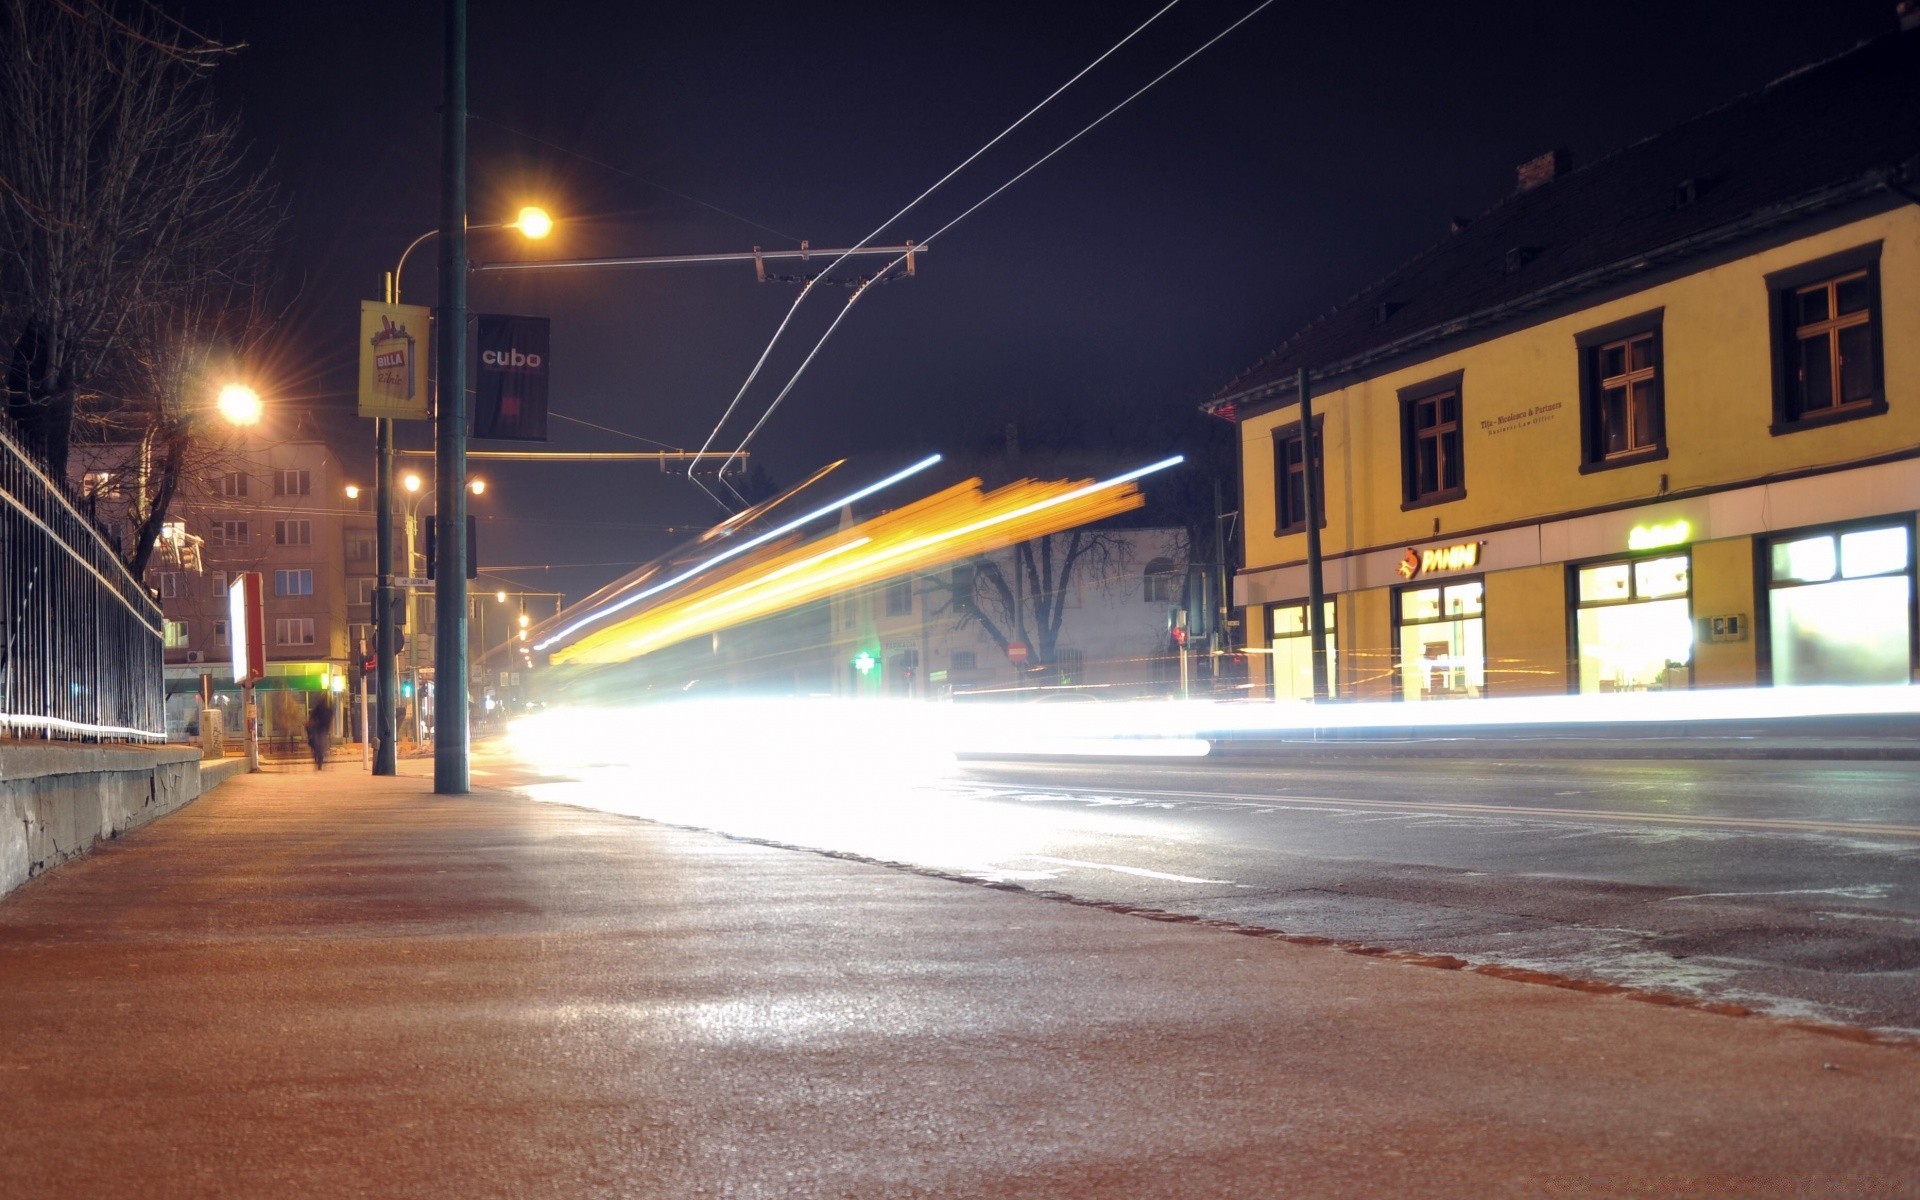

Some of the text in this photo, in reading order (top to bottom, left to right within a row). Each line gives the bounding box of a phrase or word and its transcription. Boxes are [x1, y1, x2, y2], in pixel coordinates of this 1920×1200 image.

[377, 353, 403, 367] BILLA
[482, 348, 541, 367] cubo
[1498, 412, 1527, 424] Nicolescu
[1528, 408, 1534, 417] &
[1535, 402, 1562, 414] Partners
[1533, 415, 1555, 424] Office
